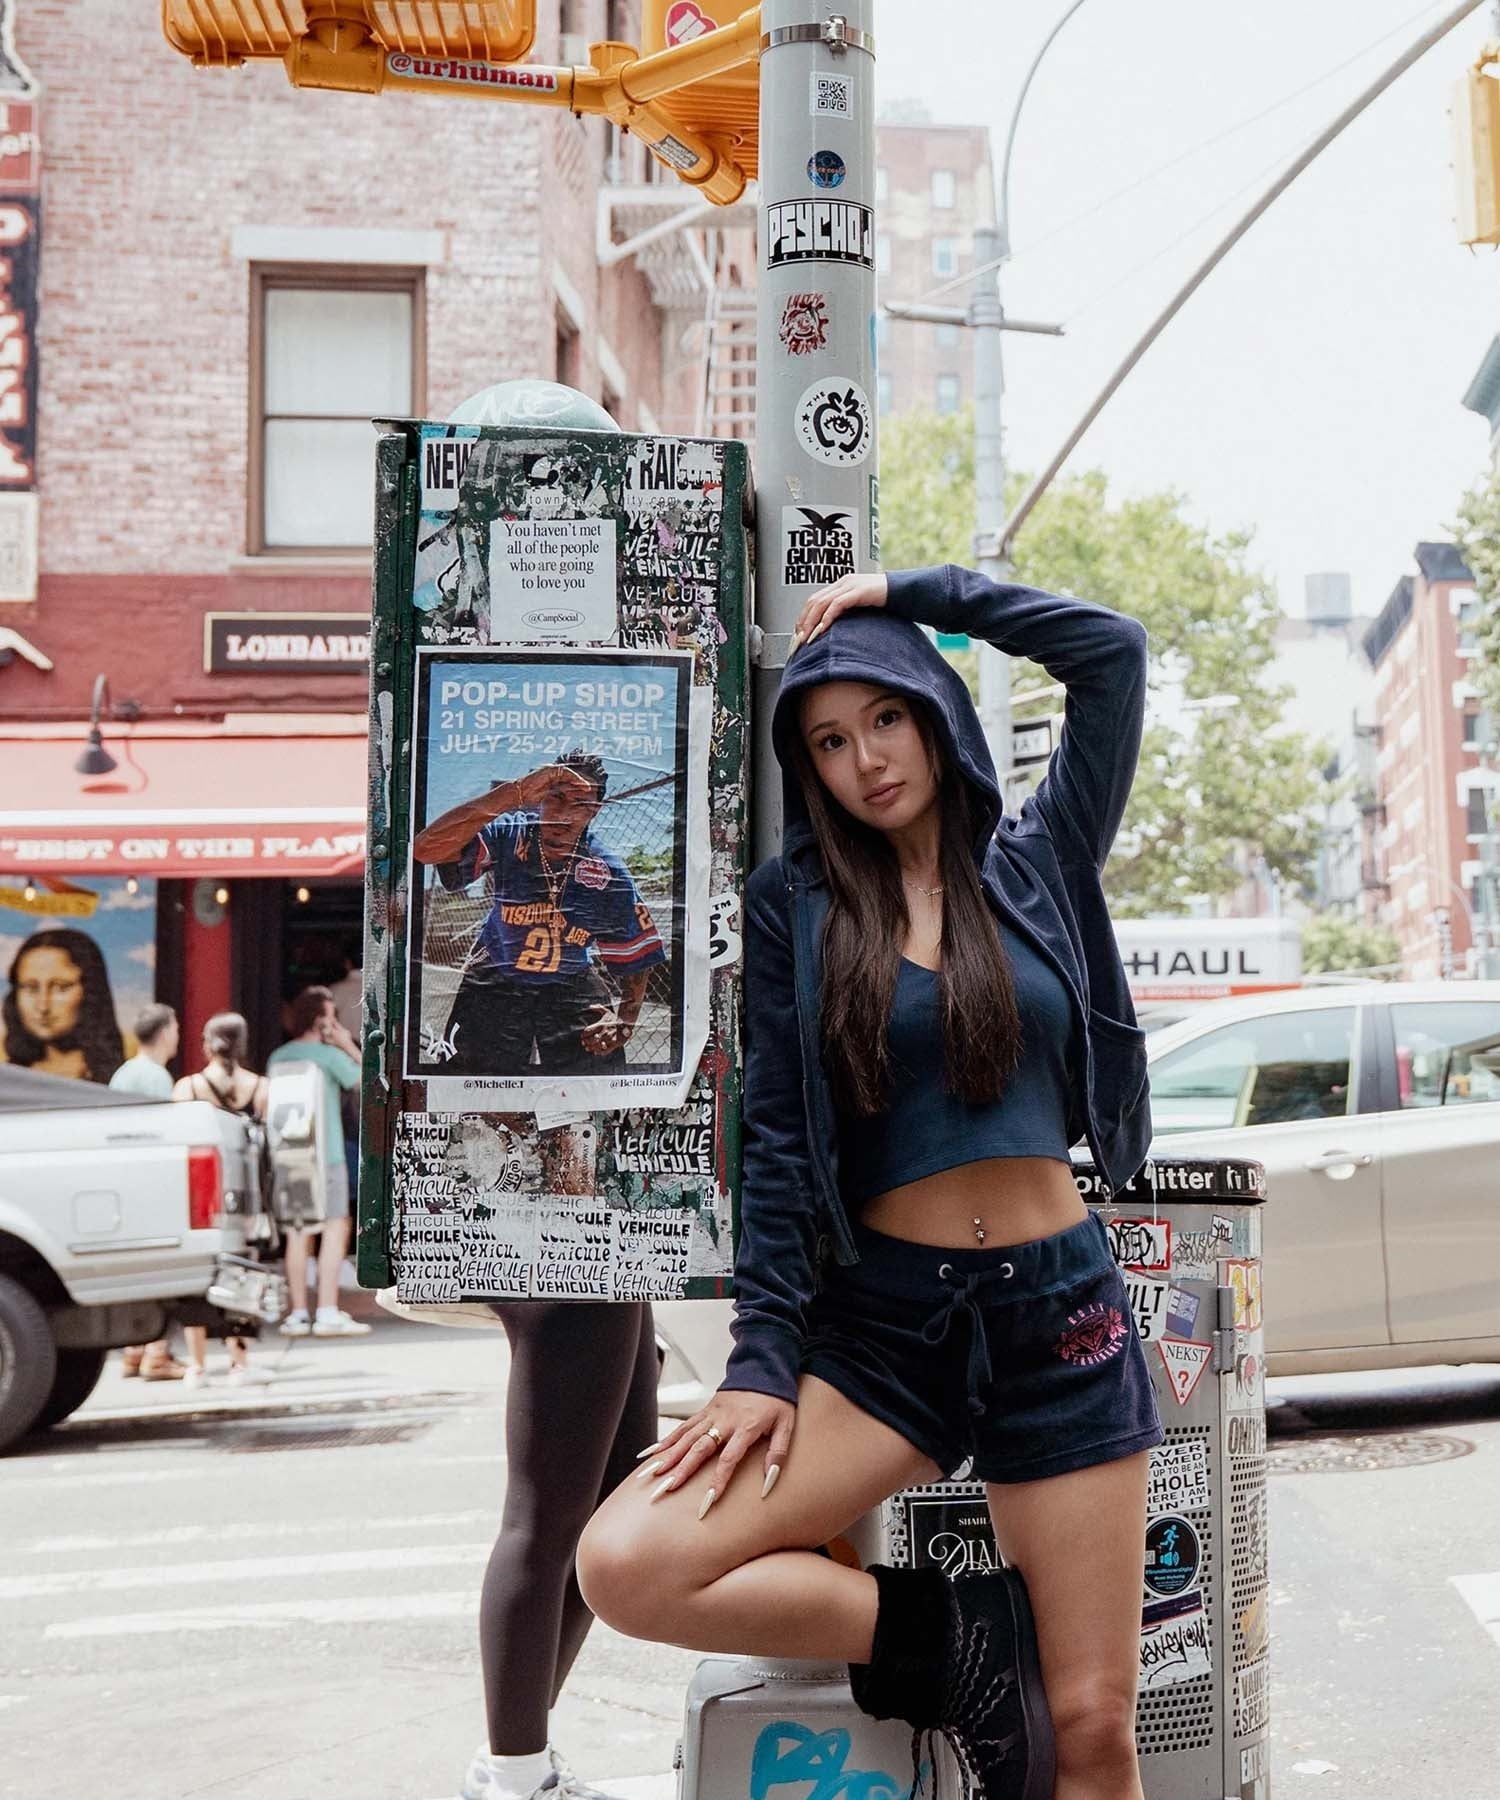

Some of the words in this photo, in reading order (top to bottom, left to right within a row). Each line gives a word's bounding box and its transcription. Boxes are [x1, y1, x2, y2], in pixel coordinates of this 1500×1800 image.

[390, 54, 555, 89] @urhuman
[806, 391, 826, 408] THE
[505, 523, 533, 537] You
[534, 523, 577, 537] haven't
[580, 524, 601, 537] met
[507, 541, 521, 554] all
[525, 540, 539, 554] of
[540, 541, 558, 554] the
[560, 540, 599, 557] people
[787, 547, 855, 567] GUMBA
[510, 558, 536, 571] who
[538, 561, 557, 571] are
[560, 557, 594, 574] going
[521, 577, 534, 589] to
[537, 576, 561, 589] love
[565, 579, 585, 592] you
[528, 613, 579, 625] @CampSocial
[441, 681, 566, 706] POP-UP
[575, 682, 665, 708] SHOP
[441, 711, 464, 729] 21
[474, 710, 564, 730] SPRING
[571, 711, 664, 731] STREET
[440, 734, 499, 754] JULY
[507, 735, 572, 755] 25-27
[119, 838, 170, 859] ON
[176, 838, 254, 859] THE
[609, 1078, 678, 1090] @BellaBanos
[1151, 1166, 1214, 1190] litter
[1165, 1345, 1206, 1363] NEKST
[1153, 1468, 1166, 1478] UP
[1169, 1466, 1179, 1475] TO
[1181, 1464, 1191, 1473] BE
[1194, 1461, 1204, 1470] AN
[1188, 1486, 1206, 1496] AM
[1190, 1496, 1206, 1505] IT
